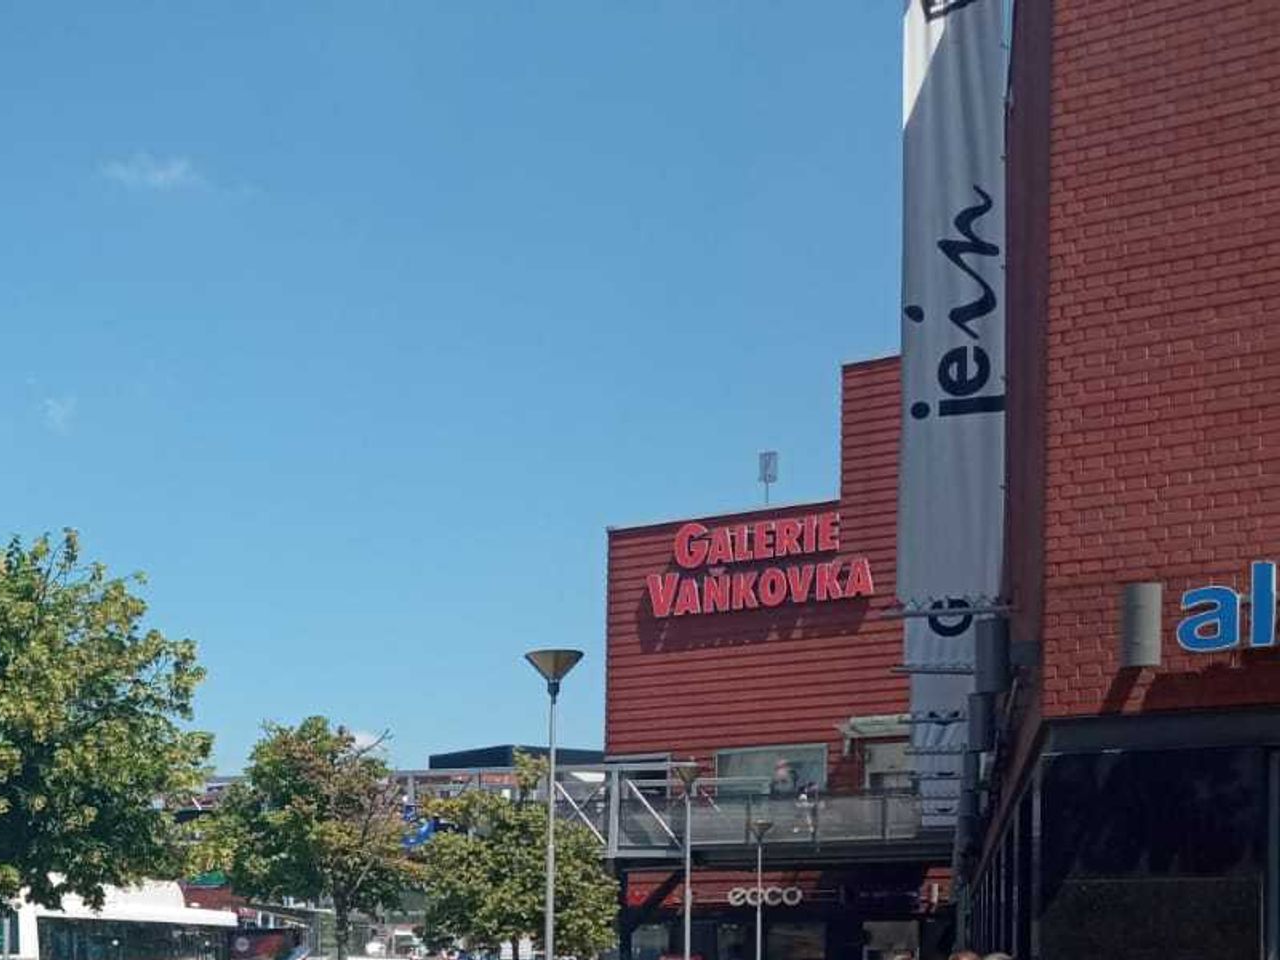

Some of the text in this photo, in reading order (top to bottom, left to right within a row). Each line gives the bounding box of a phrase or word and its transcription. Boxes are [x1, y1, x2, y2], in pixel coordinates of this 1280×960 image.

[674, 511, 841, 569] GALERIE
[646, 557, 875, 618] VAŇKOVKA
[1176, 561, 1277, 653] al
